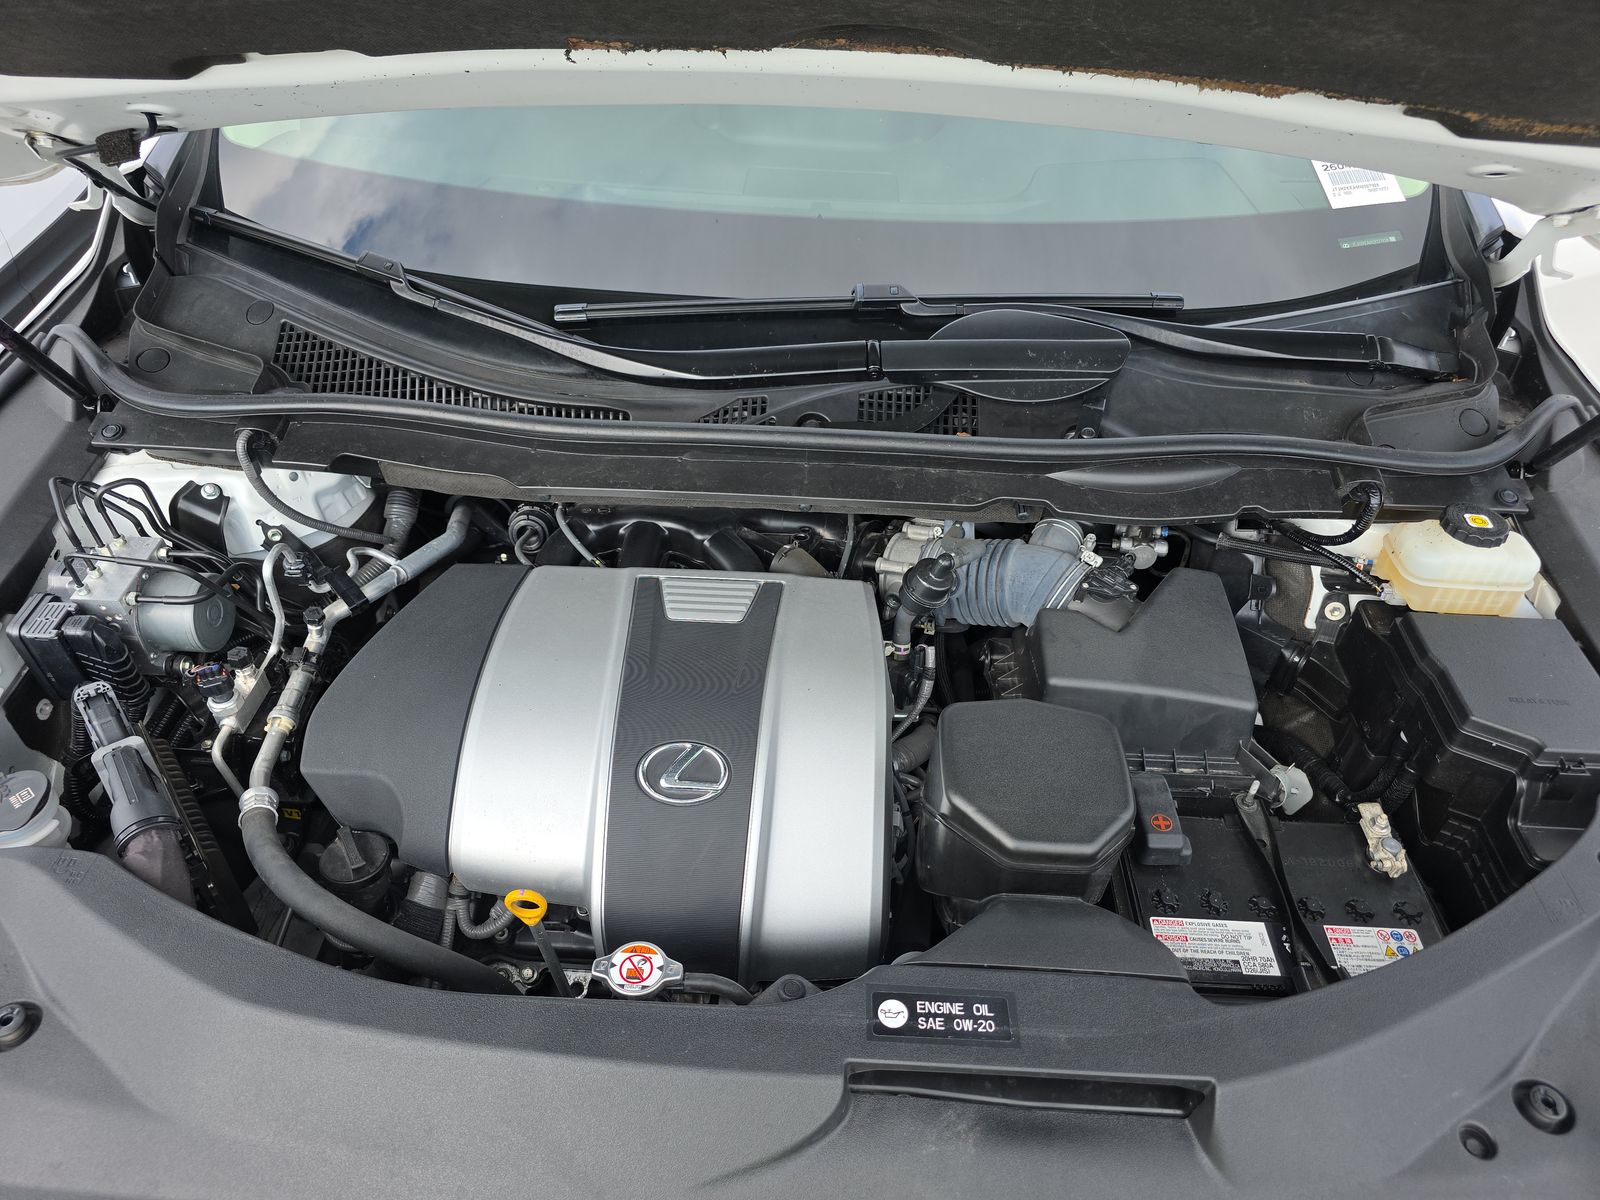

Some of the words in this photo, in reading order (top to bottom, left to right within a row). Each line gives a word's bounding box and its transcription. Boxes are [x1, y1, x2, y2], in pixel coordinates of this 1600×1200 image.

[916, 1000, 965, 1015] ENGINE
[973, 1003, 995, 1017] OIL
[917, 1017, 945, 1030] SAE
[953, 1019, 995, 1032] 0W-20
